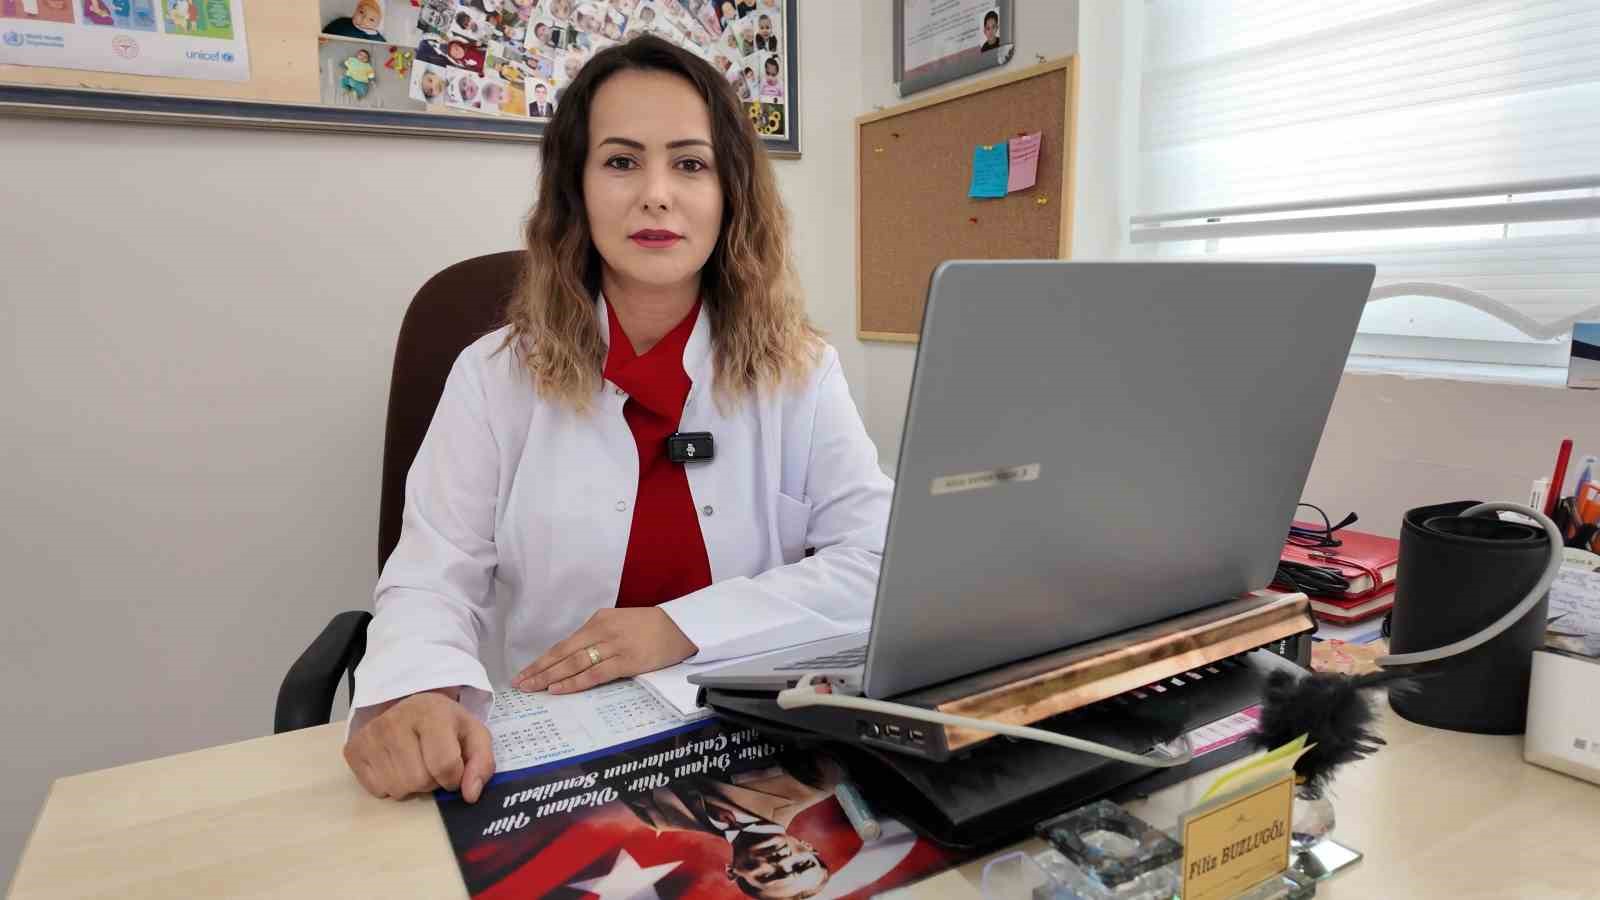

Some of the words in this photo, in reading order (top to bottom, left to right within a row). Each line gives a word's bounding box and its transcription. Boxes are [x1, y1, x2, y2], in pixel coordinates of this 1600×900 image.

[603, 734, 728, 780] Çalışanlarının
[502, 771, 599, 808] Sendikası
[536, 787, 619, 818] Vicdanı
[482, 812, 531, 836] Hür
[1189, 854, 1217, 880] Filiz
[1221, 820, 1285, 865] BUZLUGÖL
